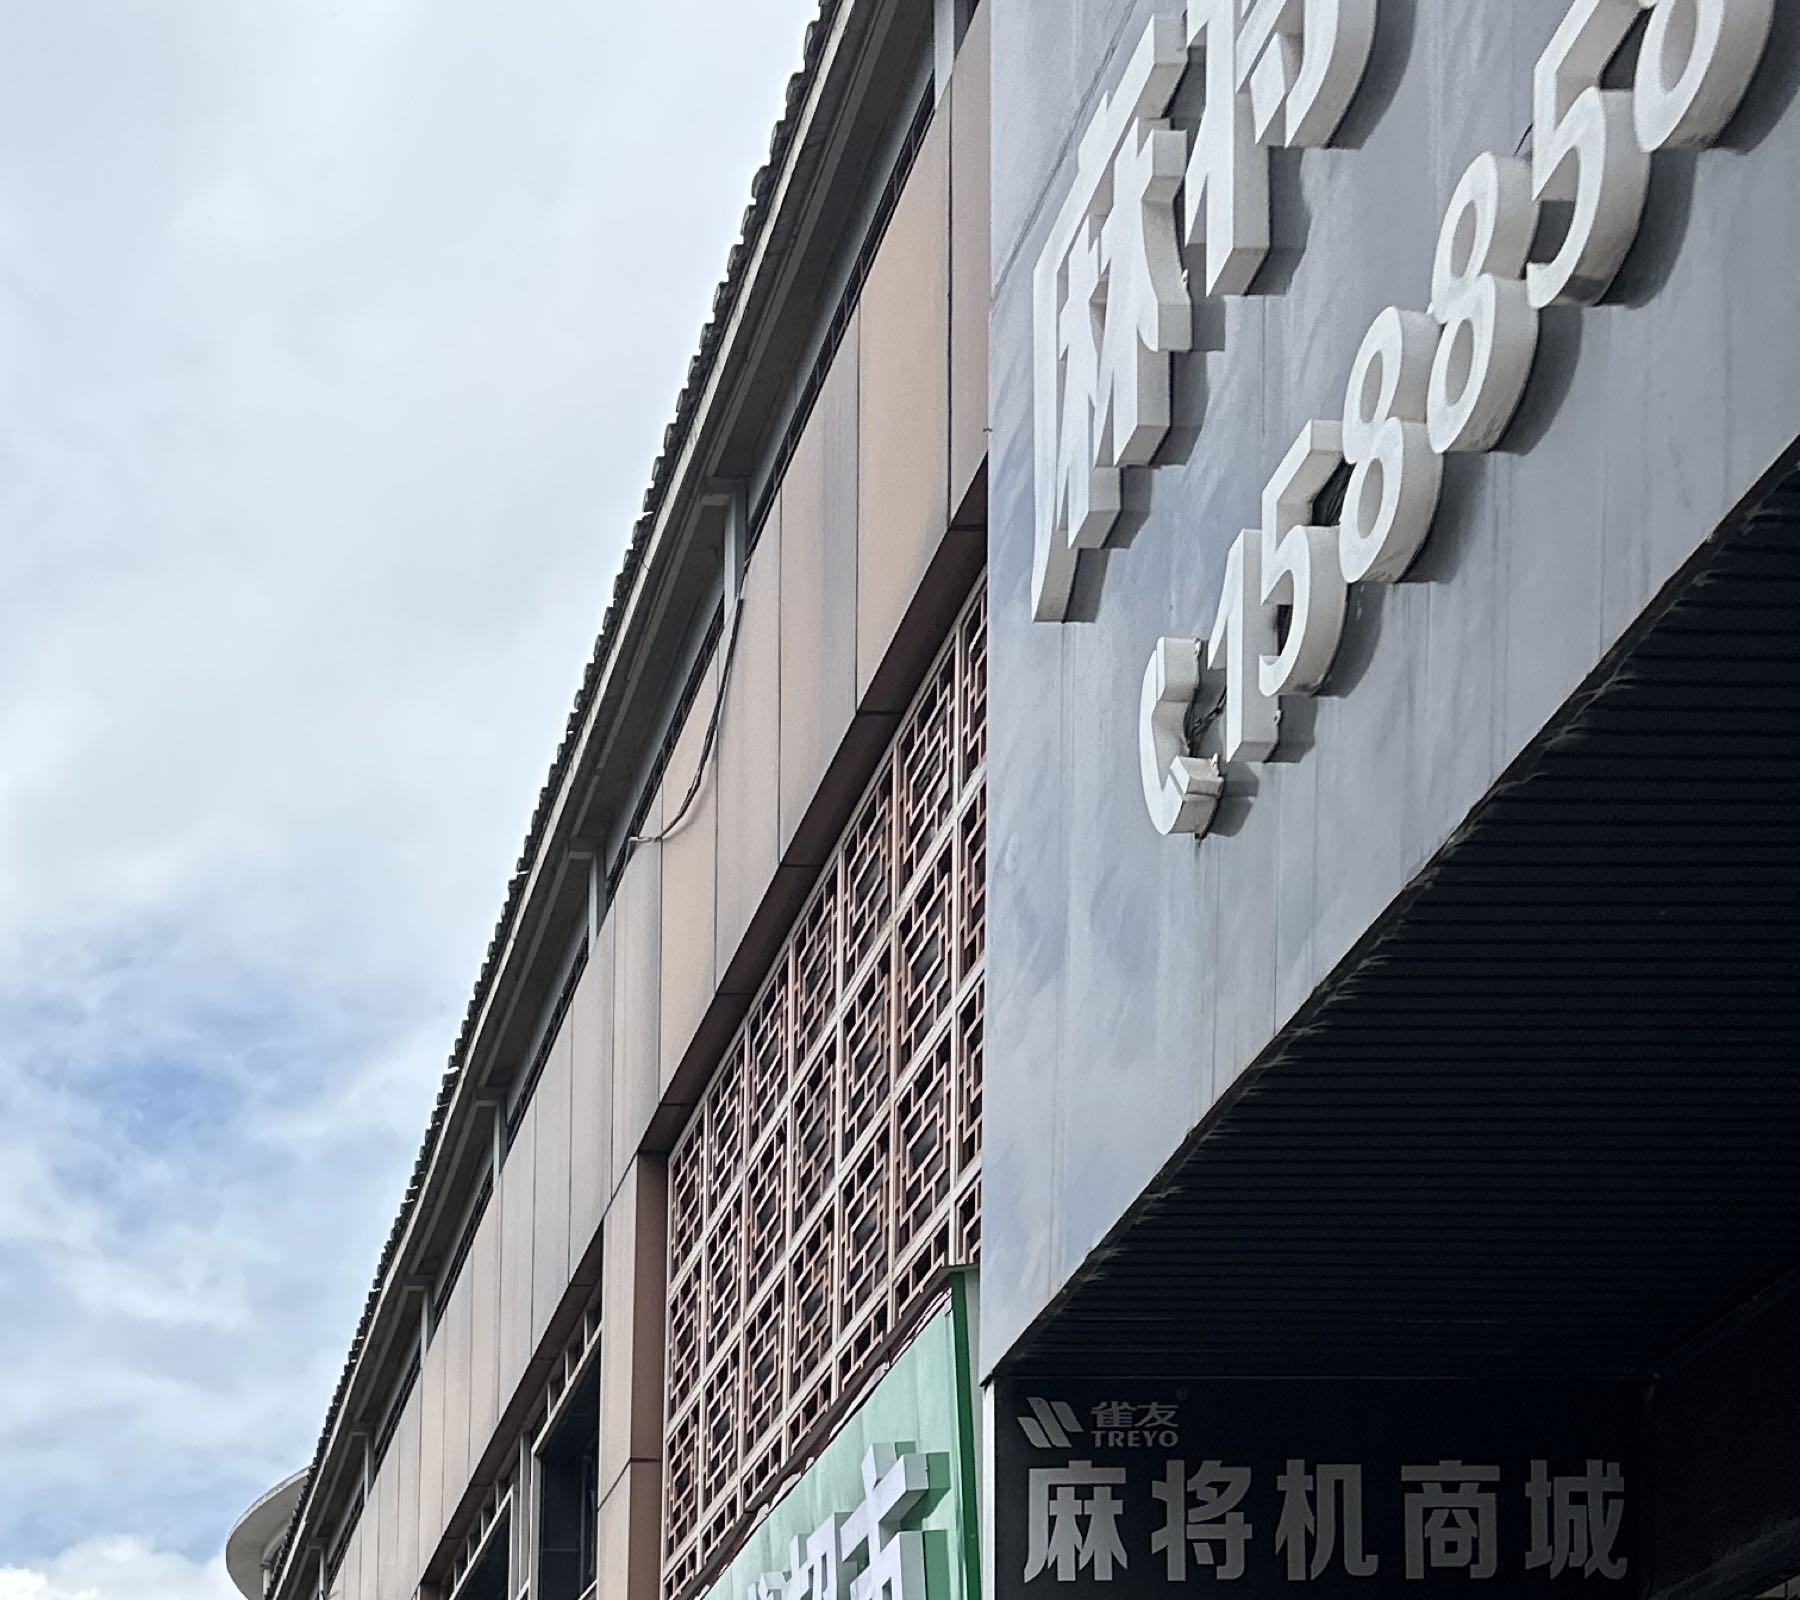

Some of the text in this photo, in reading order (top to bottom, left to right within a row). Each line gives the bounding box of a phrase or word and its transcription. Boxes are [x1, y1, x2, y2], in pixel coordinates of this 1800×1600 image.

[1091, 1401, 1179, 1428] 雀友
[1091, 1430, 1179, 1447] TREYO
[1023, 1458, 1628, 1583] 麻将机商城
